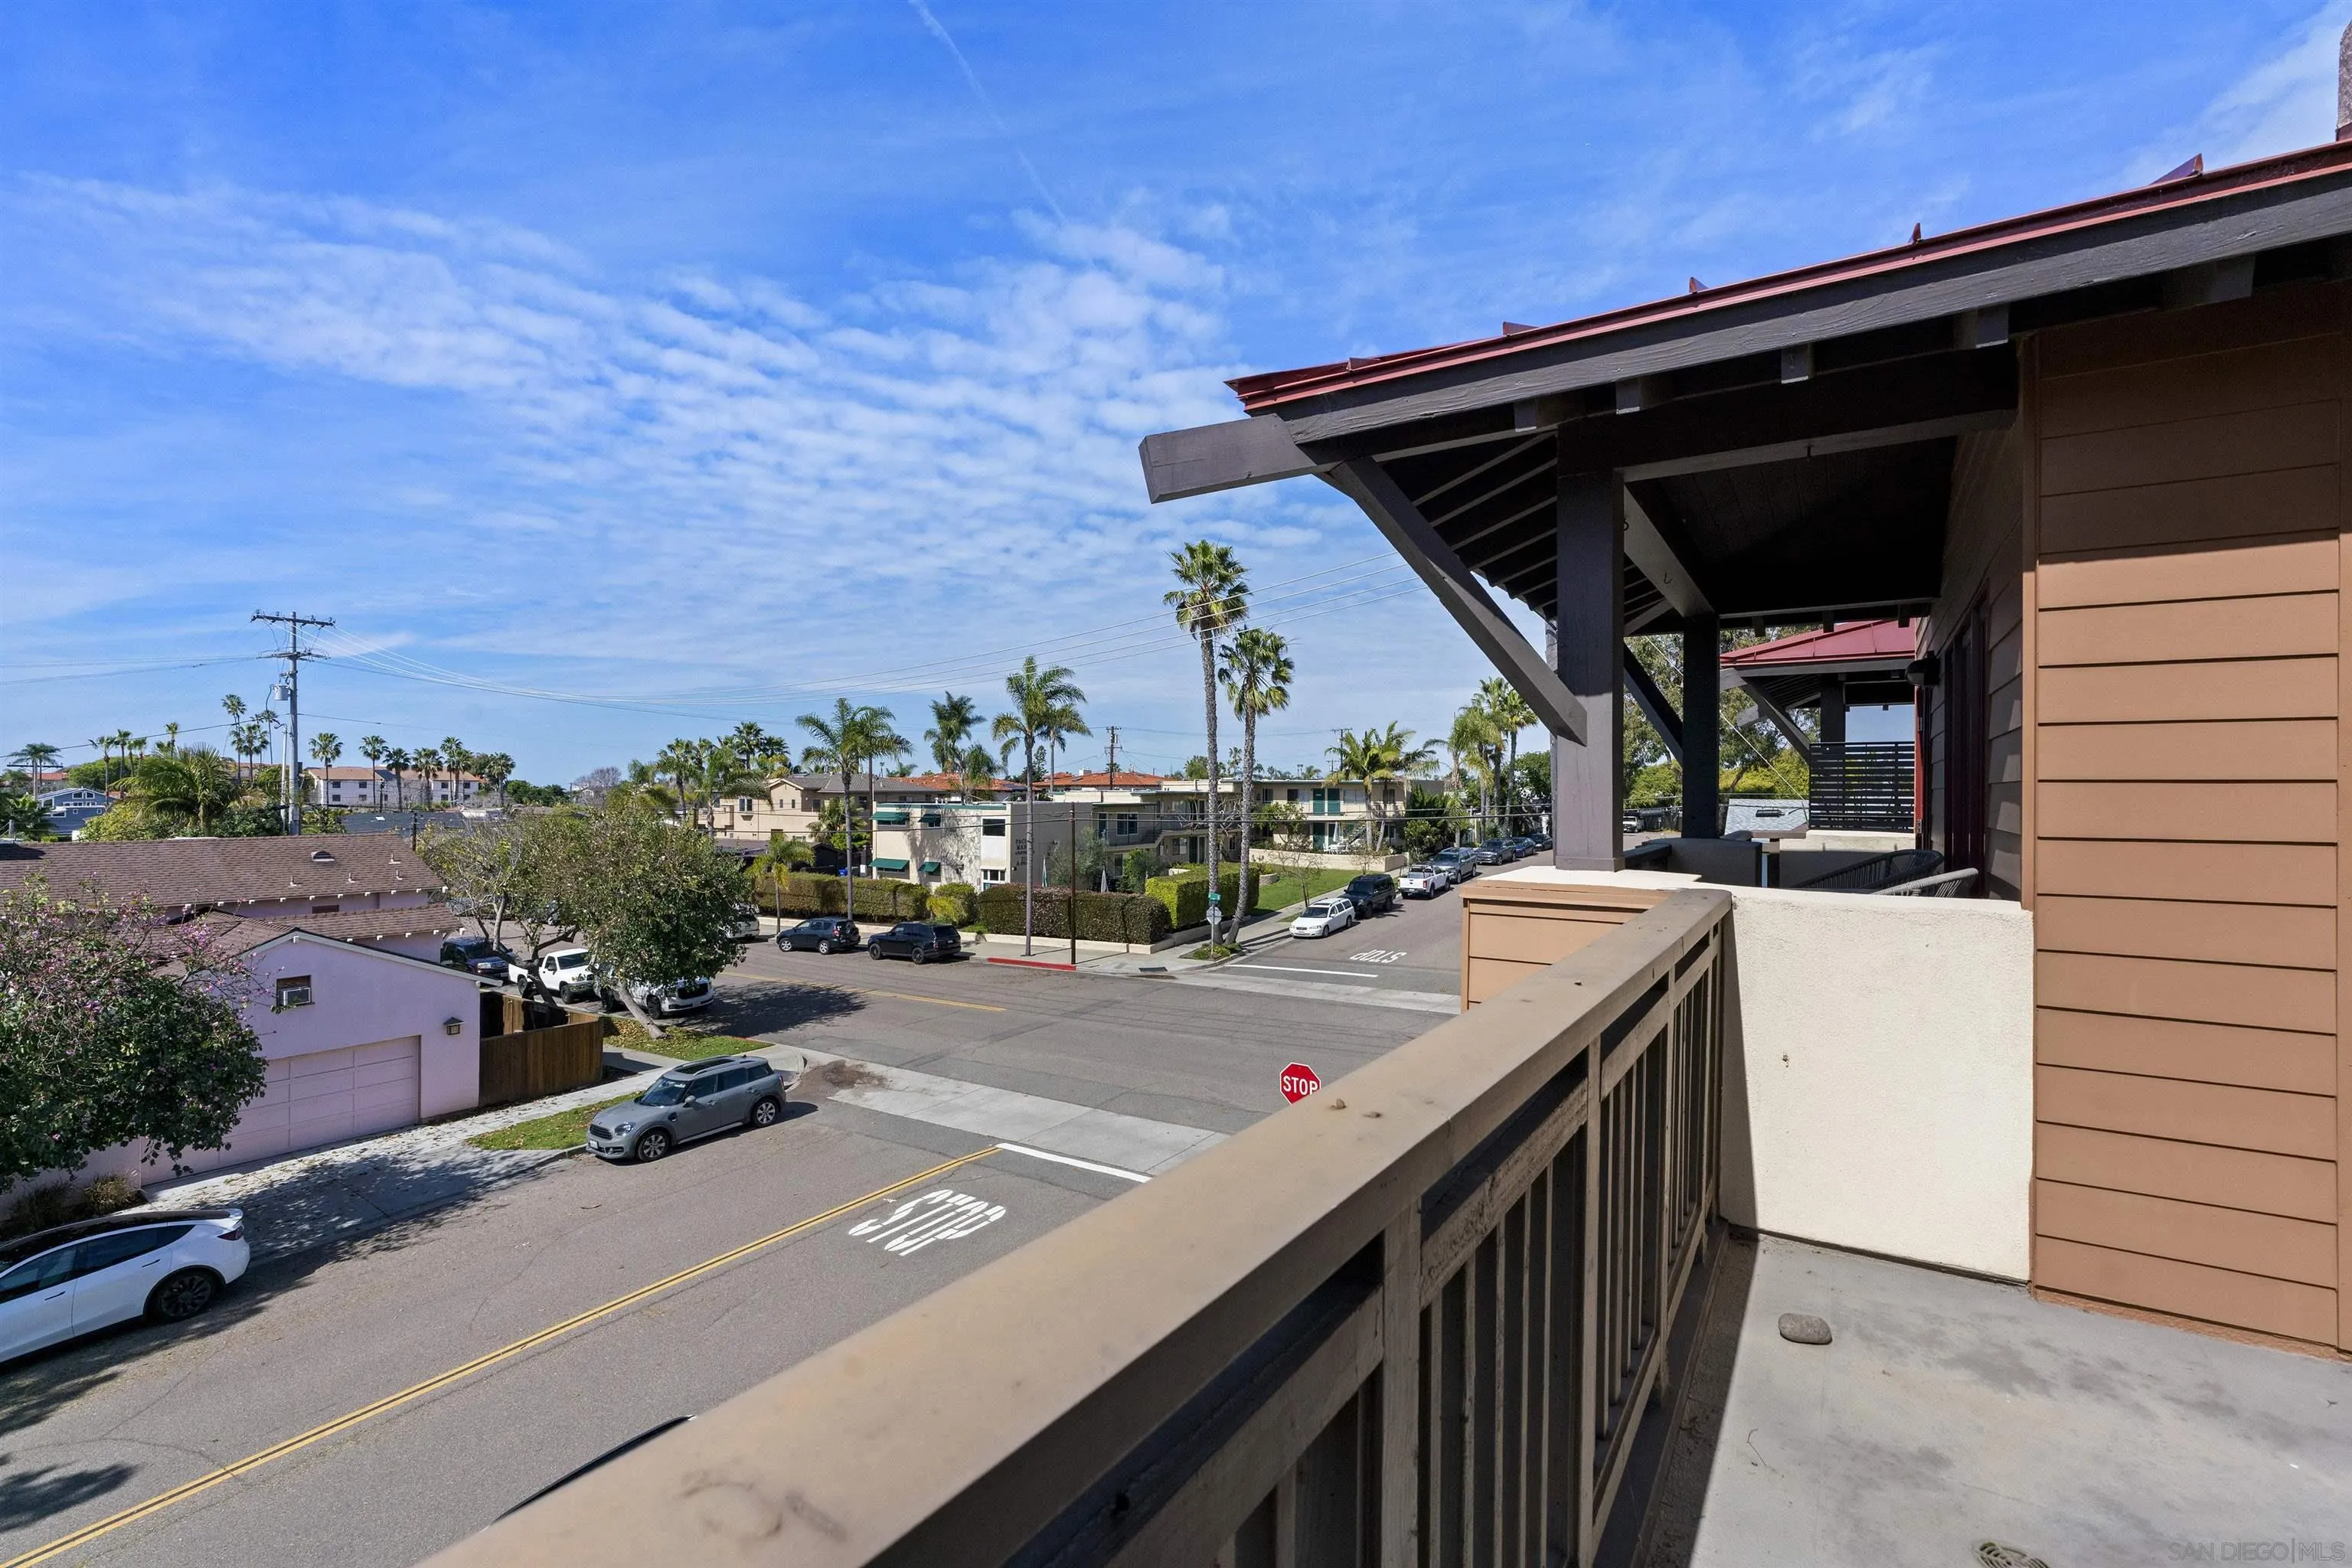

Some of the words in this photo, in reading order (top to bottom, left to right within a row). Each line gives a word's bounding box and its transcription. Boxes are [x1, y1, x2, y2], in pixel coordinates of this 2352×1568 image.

[1350, 949, 1406, 963] STOP
[1283, 1075, 1318, 1095] STOP
[848, 1189, 1006, 1256] STOP
